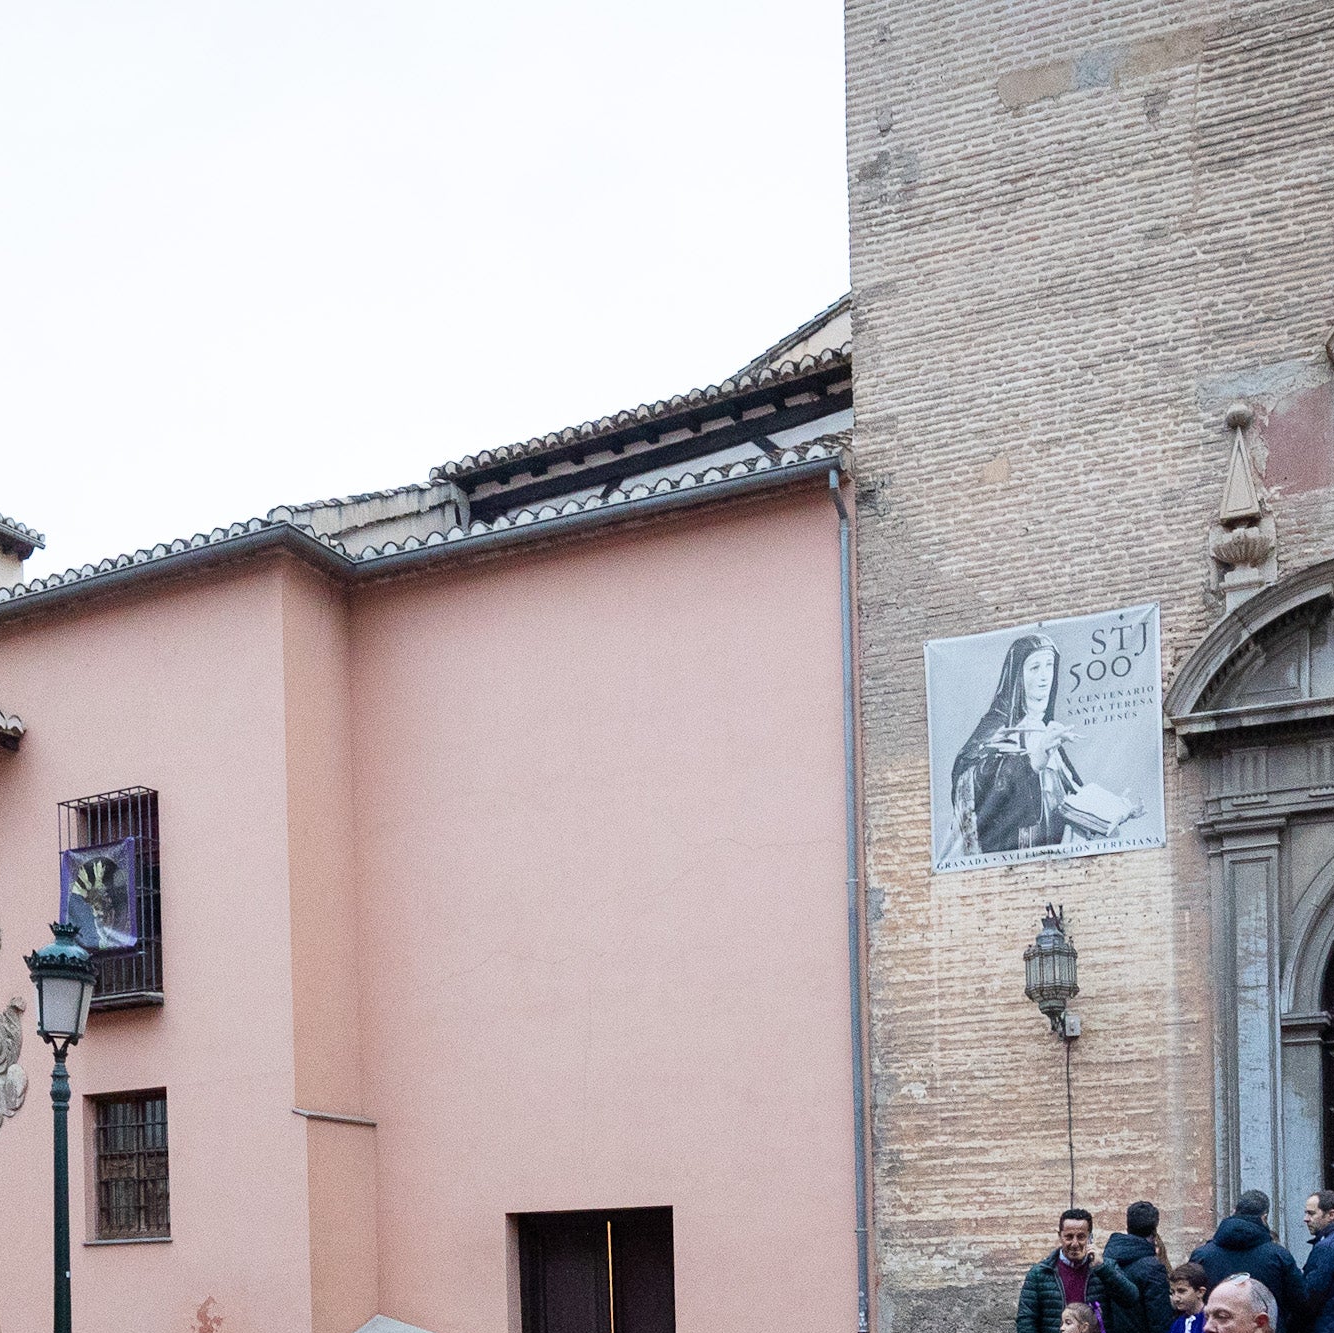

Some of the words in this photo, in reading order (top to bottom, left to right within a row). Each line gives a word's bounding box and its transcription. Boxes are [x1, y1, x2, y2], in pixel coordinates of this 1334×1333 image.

[1091, 622, 1148, 656] STJ
[1069, 656, 1132, 693] 500
[1066, 697, 1073, 705] V
[1078, 686, 1154, 704] CENTENARIO
[1067, 705, 1104, 717] SANTA
[1109, 698, 1154, 711] TERESA
[1084, 717, 1098, 727] DE
[936, 857, 989, 870] GRANADA
[1000, 853, 1021, 862] XVI
[1096, 836, 1161, 850] TERESIANA
